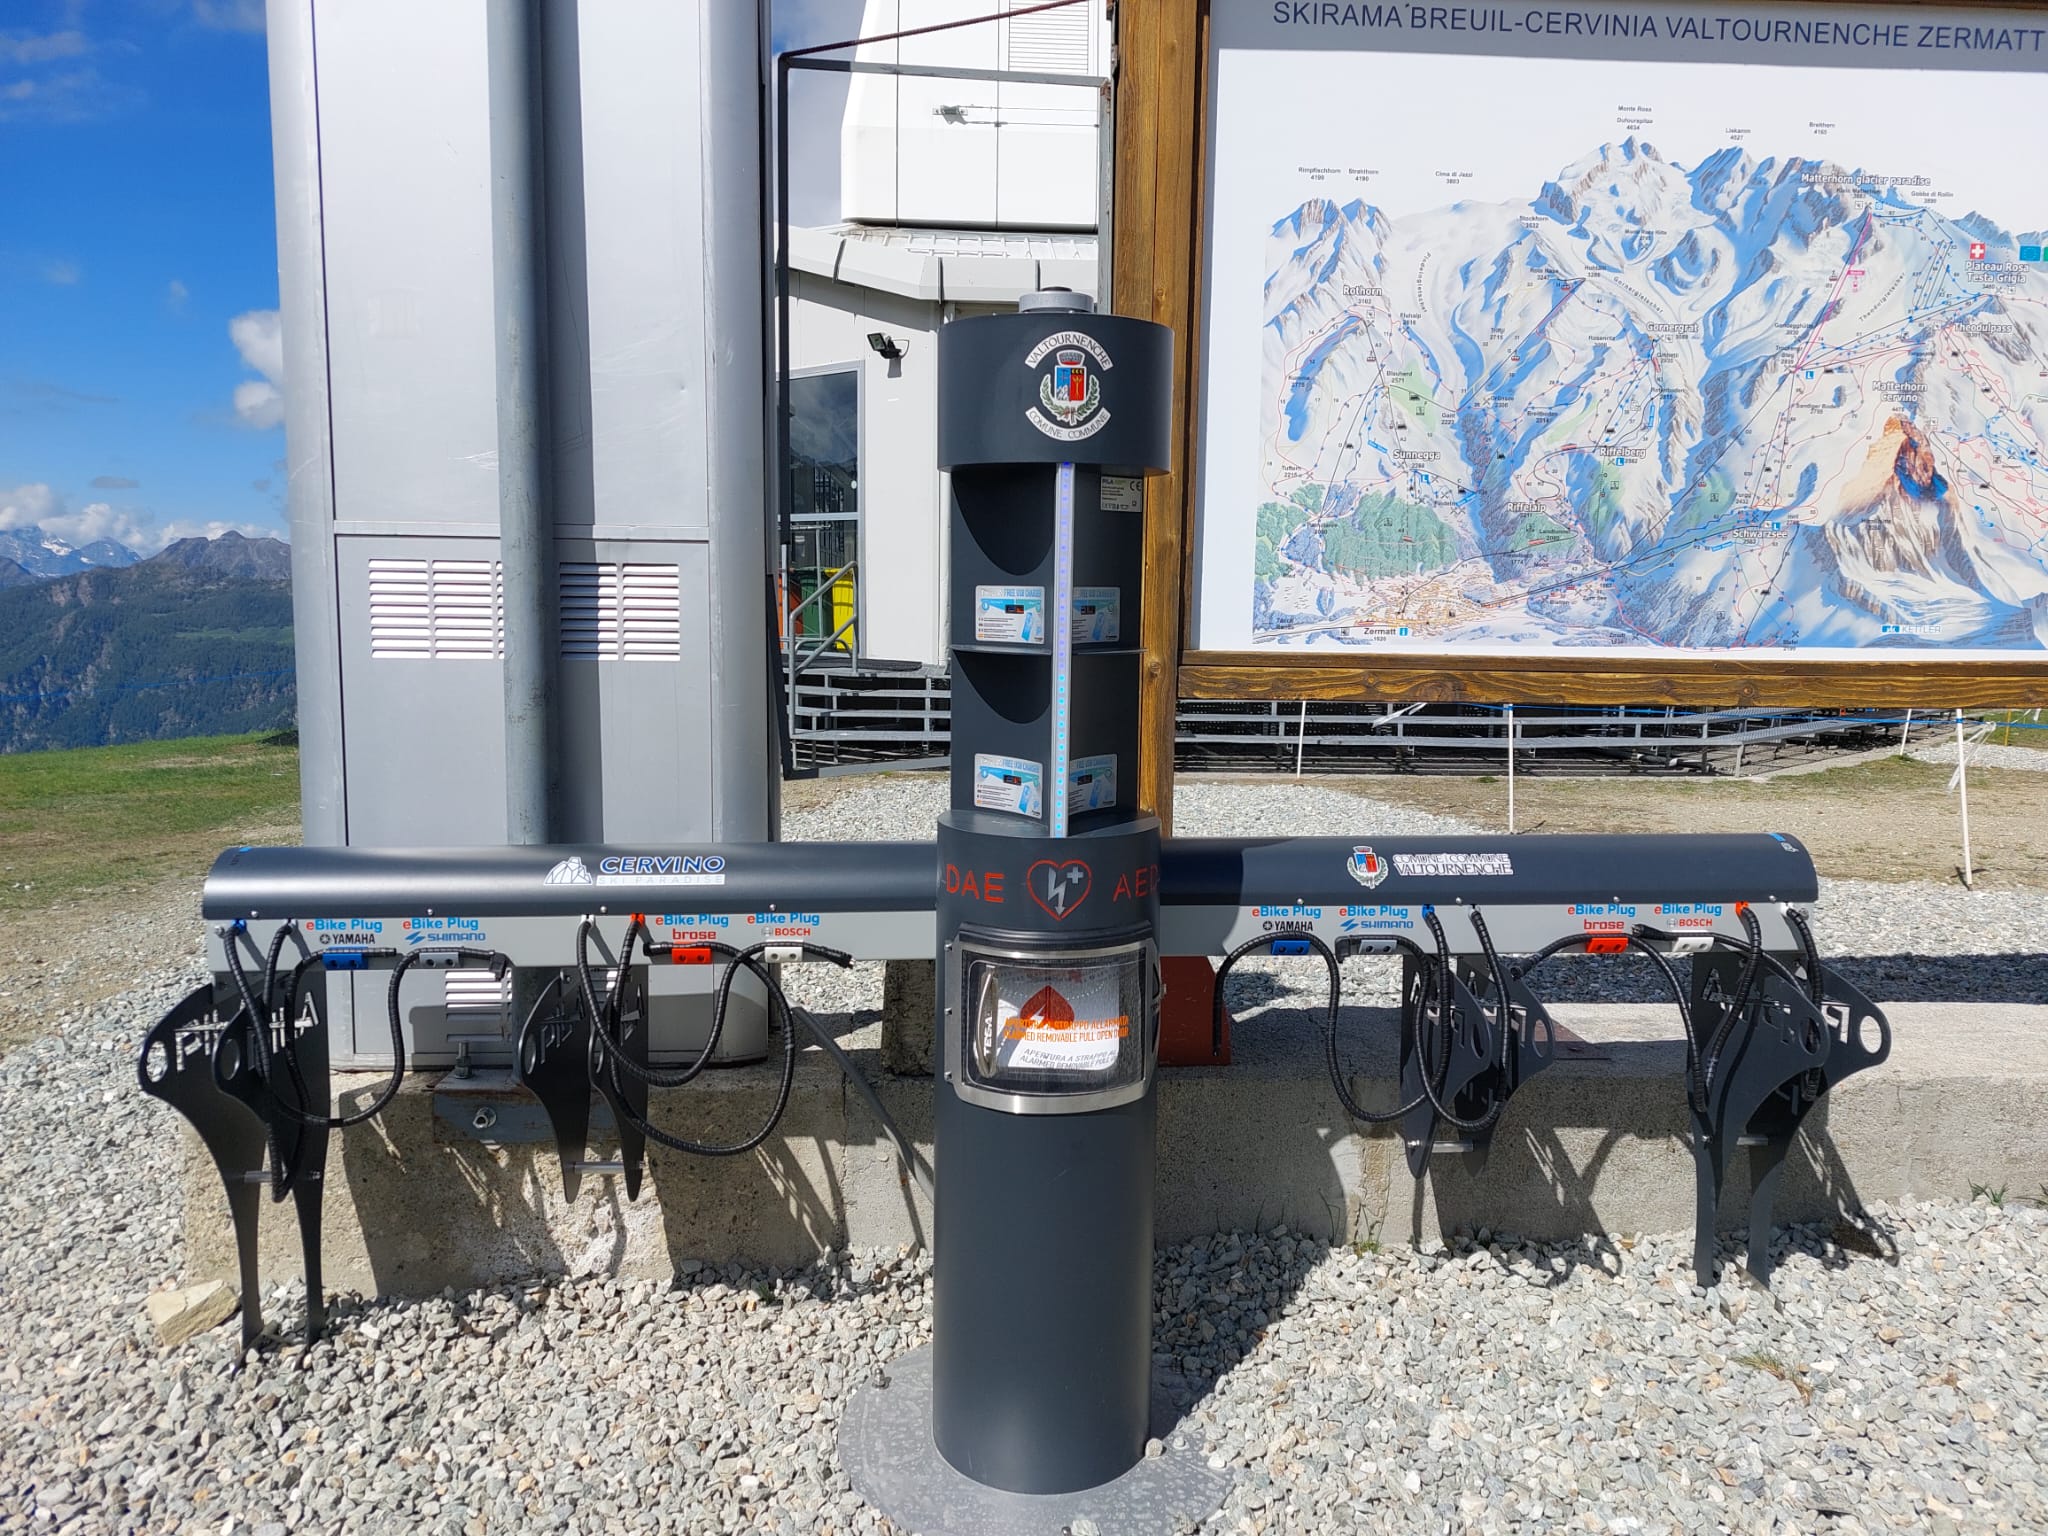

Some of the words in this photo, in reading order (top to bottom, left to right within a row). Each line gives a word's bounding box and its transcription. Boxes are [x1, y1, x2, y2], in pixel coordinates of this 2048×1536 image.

[1665, 16, 1909, 49] VALTOURNENCHE
[1917, 25, 2046, 52] ZERMATT
[1801, 173, 1854, 184] Matterhorn
[1855, 174, 1889, 187] glacier
[1890, 176, 1932, 188] paradise
[1964, 261, 2004, 274] Plateau
[2004, 262, 2030, 274] Rosa
[1967, 273, 1996, 284] Testa
[1996, 273, 2027, 285] Grigia
[1343, 284, 1382, 297] Rothorn
[1646, 322, 1699, 334] Gornergrat
[1953, 322, 2013, 335] Theodulpass
[1027, 333, 1111, 369] VALTOURNENCHE
[1872, 381, 1928, 392] Matterhorn
[1881, 393, 1918, 403] Cervino
[1029, 410, 1063, 439] COMUNE
[1067, 410, 1110, 440] COMMUNE
[1393, 451, 1440, 461] Sunnegga
[1599, 447, 1646, 459] Riffelberg
[1507, 503, 1546, 514] Riffelalp
[1732, 529, 1788, 540] Schwarzsee
[1363, 627, 1396, 636] Zermatt
[600, 856, 726, 874] CERVINO
[1395, 863, 1514, 875] VALTOURNENCHE
[597, 875, 625, 884] SKI
[634, 875, 724, 884] PARADISE
[945, 863, 1006, 904] DAE
[1252, 905, 1289, 917] eBike
[1292, 906, 1322, 919] Plug
[1339, 905, 1376, 917] eBike
[1379, 906, 1409, 919] Plug
[1567, 903, 1604, 915] eBike
[1607, 904, 1636, 917] Plug
[1654, 903, 1690, 915] eBike
[1694, 904, 1722, 917] Plug
[402, 917, 443, 930] eBike
[447, 917, 479, 931] Plug
[656, 913, 695, 926] eBike
[698, 914, 729, 927] Plug
[747, 912, 786, 924] eBike
[789, 912, 820, 926] Plug
[1360, 920, 1414, 929] SHIMANO
[1583, 919, 1625, 930] brose
[1679, 919, 1713, 927] BOSCH
[306, 919, 347, 931] eBike
[351, 919, 383, 933] Plug
[774, 927, 811, 937] BOSCH
[1274, 921, 1314, 931] YAMAHA
[332, 934, 376, 945] YAMAHA
[427, 932, 486, 942] SHIMANO
[672, 928, 717, 940] brose
[1037, 1032, 1079, 1043] REMOVABLE
[1080, 1031, 1095, 1042] PULL
